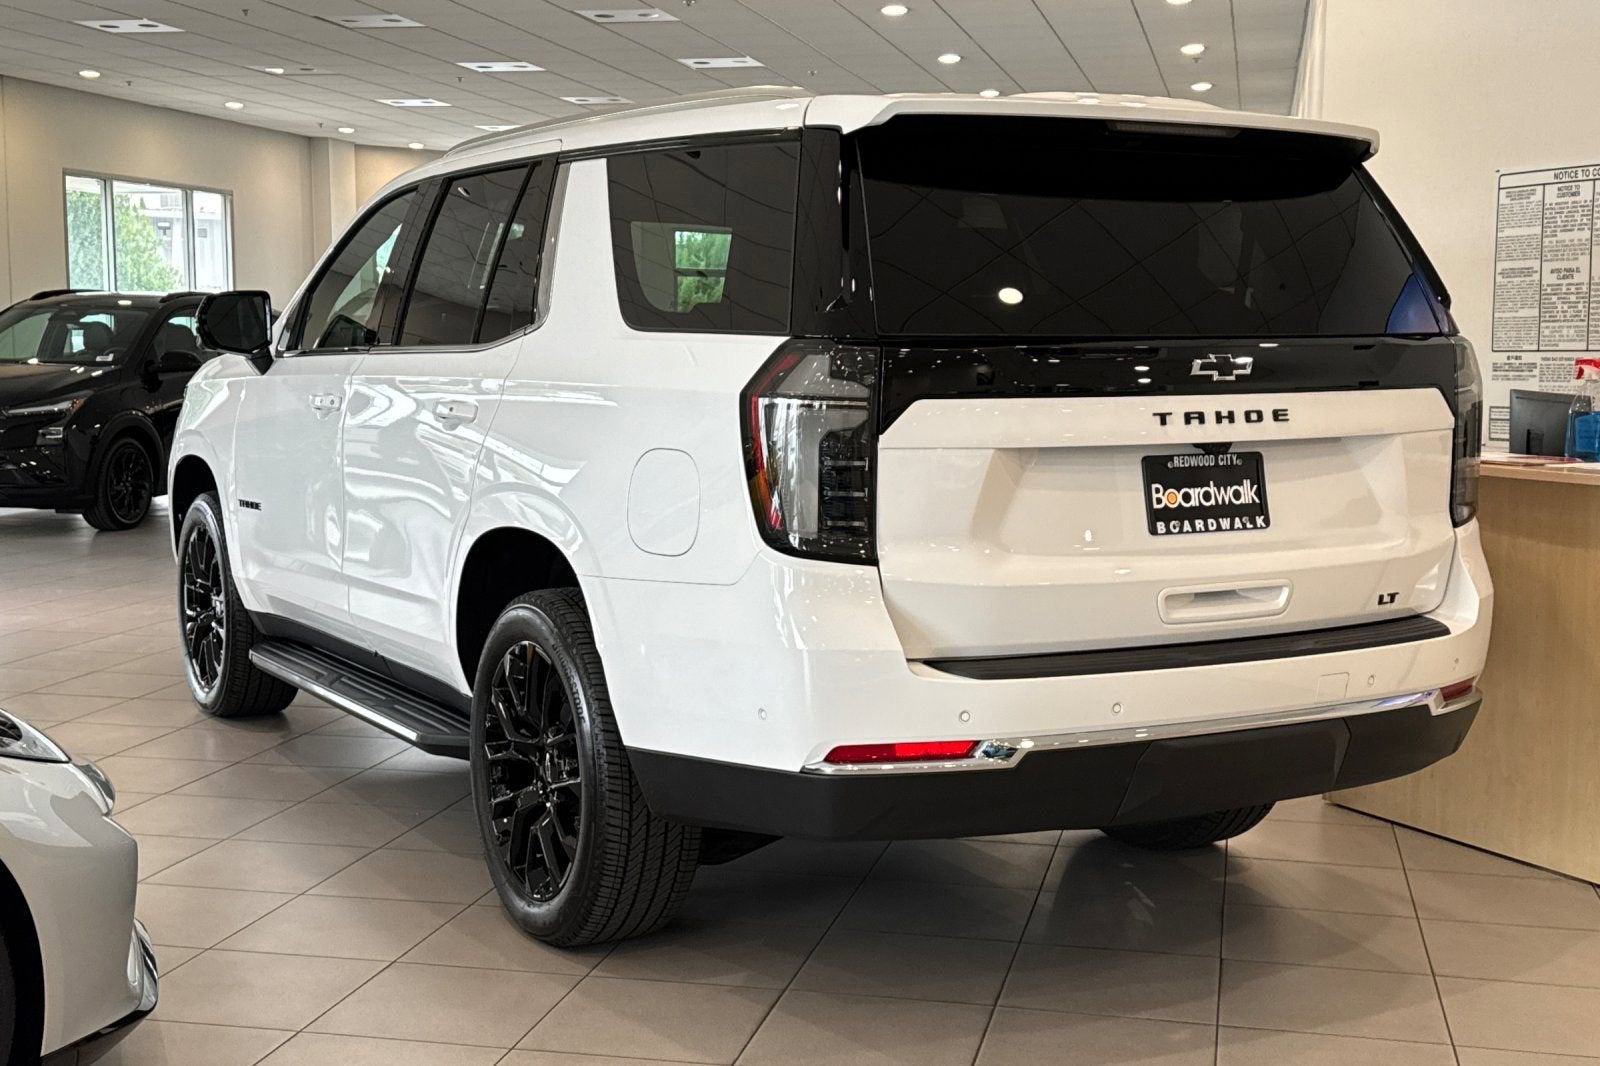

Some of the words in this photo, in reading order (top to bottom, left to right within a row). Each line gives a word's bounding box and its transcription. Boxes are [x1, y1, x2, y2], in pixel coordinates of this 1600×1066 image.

[1553, 169, 1579, 180] NOTICE
[1581, 168, 1590, 178] TO
[1152, 408, 1290, 426] TAHOE
[1173, 455, 1215, 468] REDWOOD
[1218, 454, 1237, 466] CITY
[1151, 479, 1260, 509] Boardwalk
[238, 499, 262, 511] TAHOE
[1156, 515, 1266, 534] BOARDWALK
[1377, 591, 1400, 605] LT
